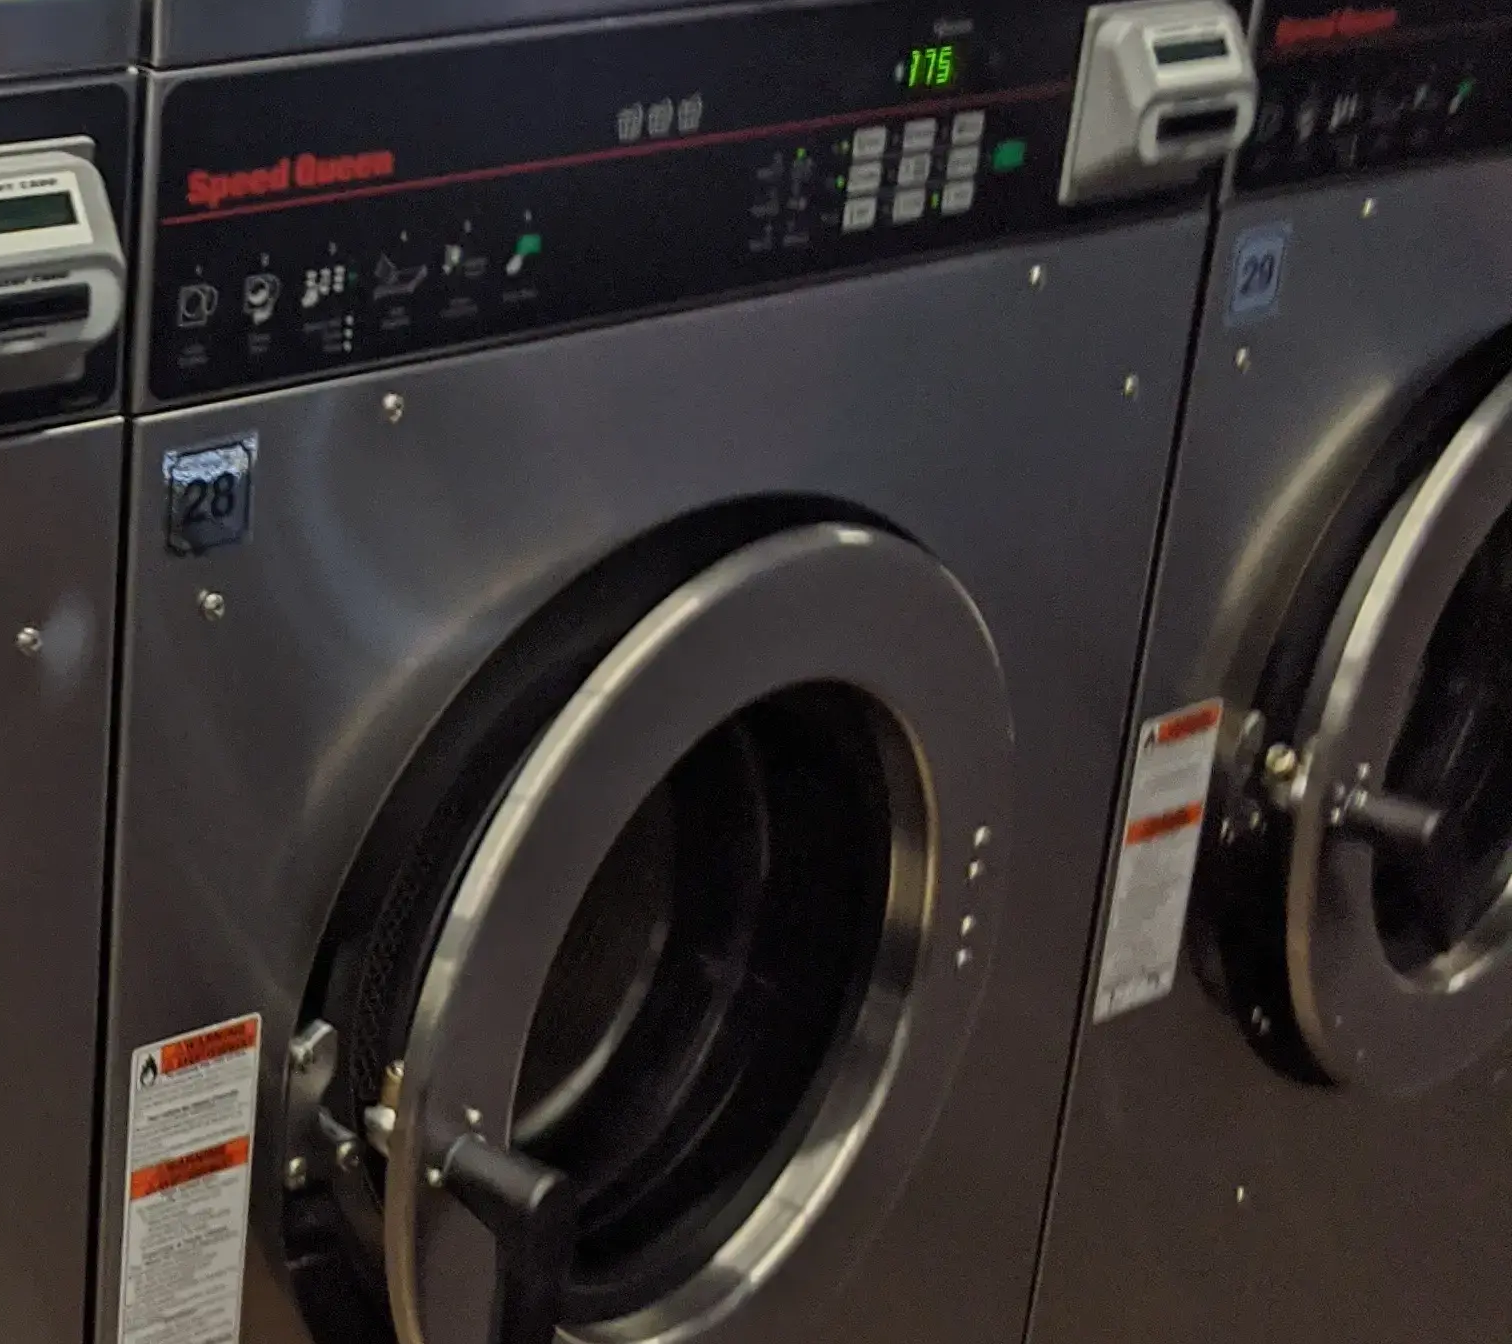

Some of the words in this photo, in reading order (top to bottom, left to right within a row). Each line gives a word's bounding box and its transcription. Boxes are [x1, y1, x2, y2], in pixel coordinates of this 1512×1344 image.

[909, 45, 953, 87] 175
[186, 158, 290, 209] Speed
[295, 150, 394, 188] Queen
[184, 471, 235, 524] 28
